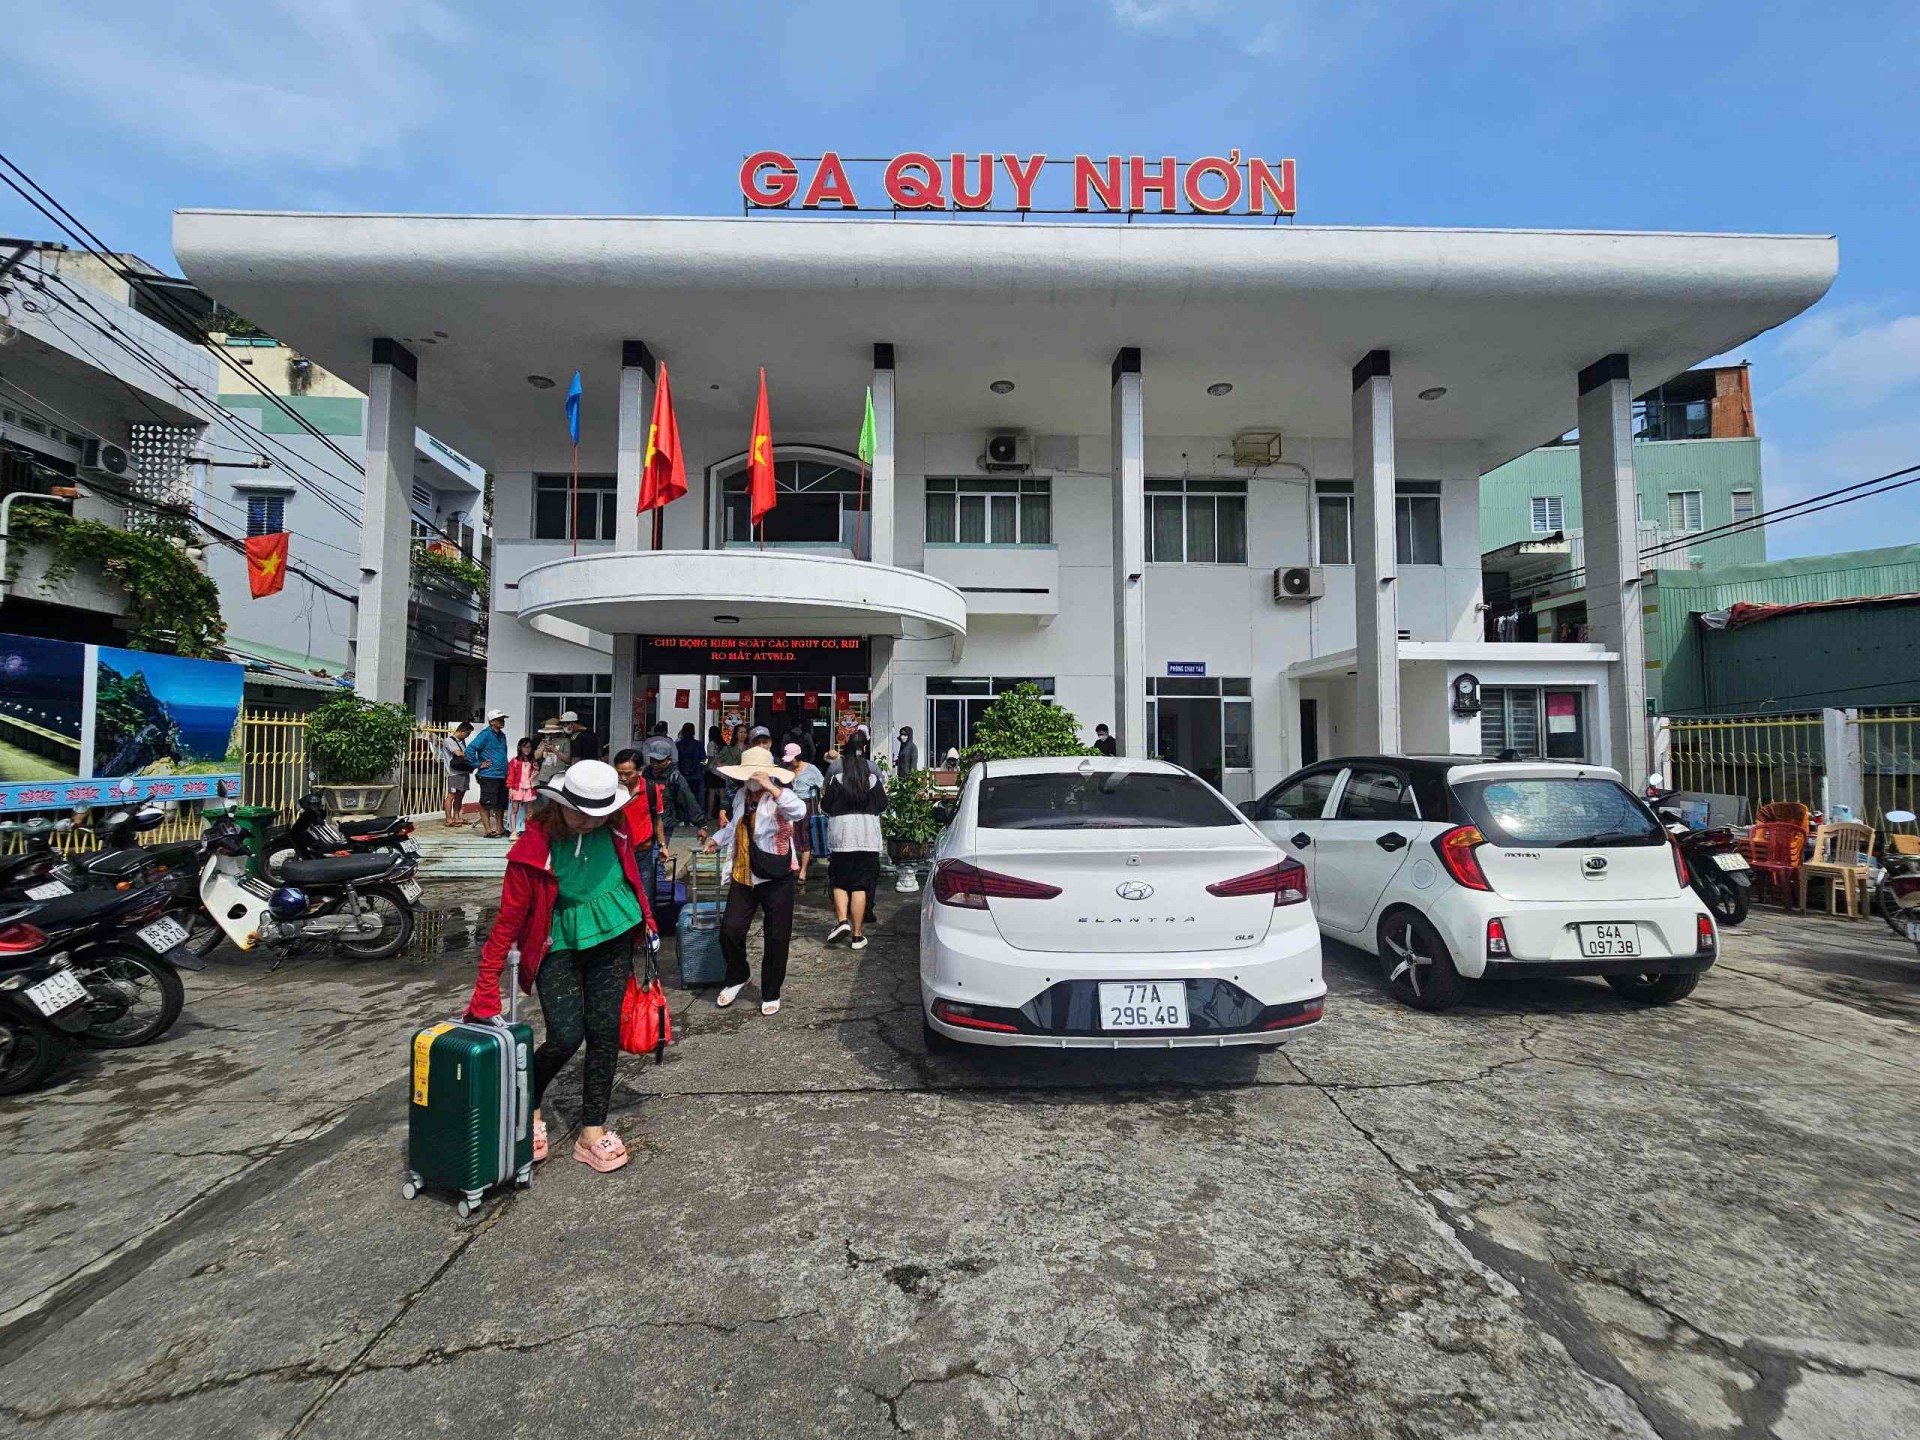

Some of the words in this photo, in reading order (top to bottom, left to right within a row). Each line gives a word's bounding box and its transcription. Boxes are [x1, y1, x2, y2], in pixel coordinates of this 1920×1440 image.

[739, 150, 860, 209] GA
[884, 152, 1047, 211] QUY
[1074, 149, 1297, 215] NHƠN
[791, 639, 820, 648] NGUY
[711, 652, 727, 661] RO
[1589, 860, 1605, 868] KIA
[144, 920, 173, 940] 86-B6
[152, 927, 186, 951] 518.20
[1597, 926, 1621, 939] 64A
[1590, 941, 1633, 954] 097.38
[33, 974, 70, 998] 77-L1
[1124, 984, 1161, 1004] 77A
[1111, 1006, 1179, 1026] 296.48
